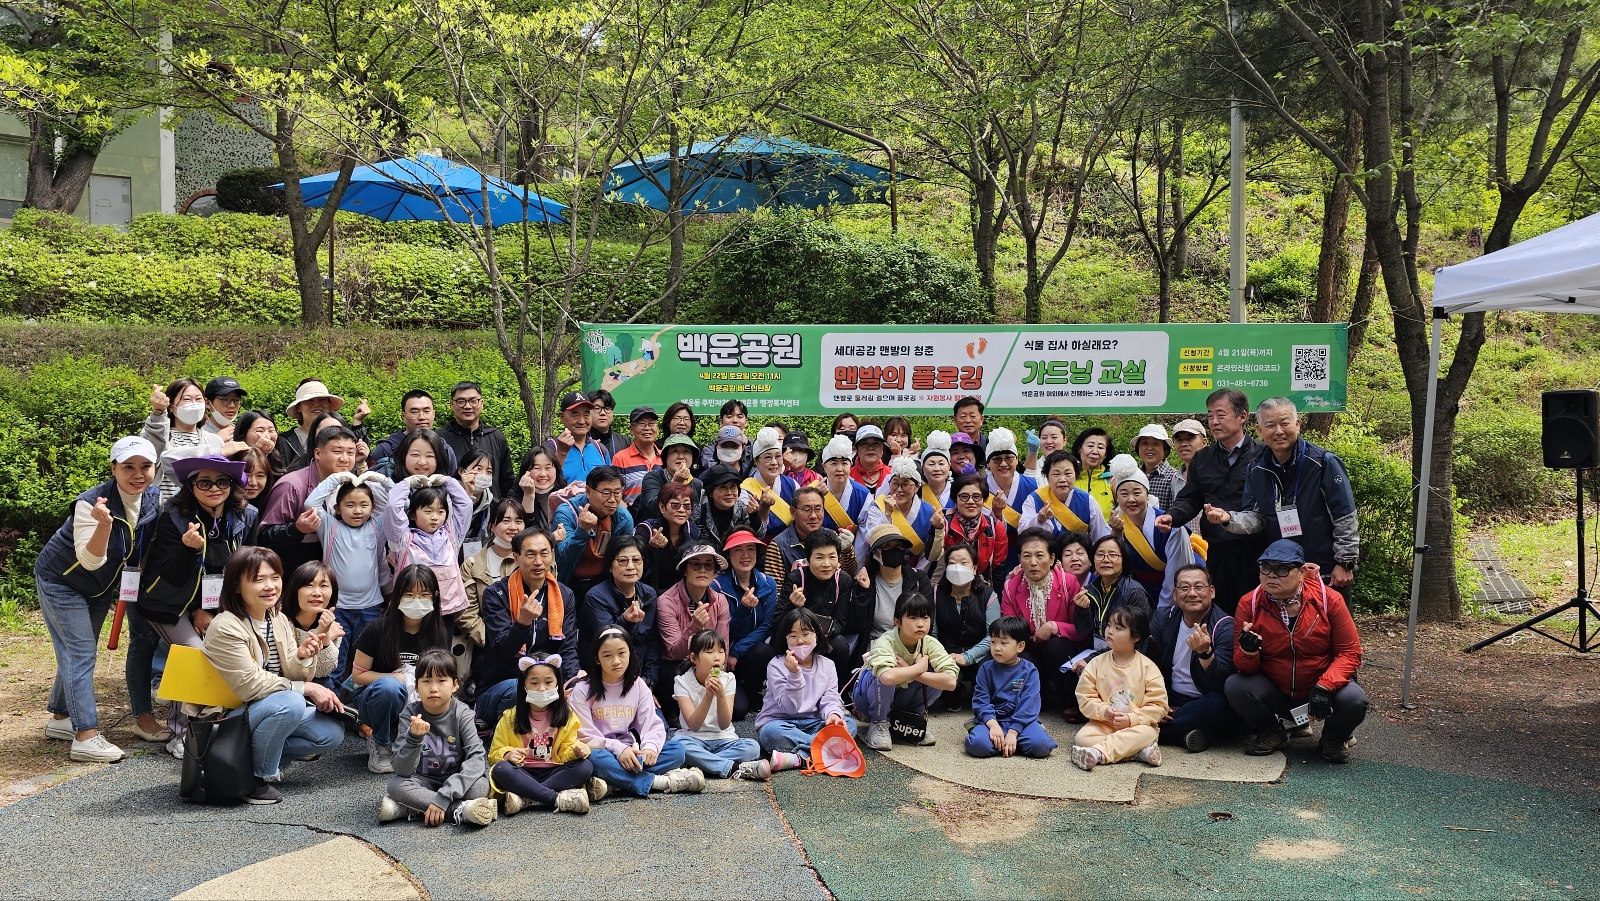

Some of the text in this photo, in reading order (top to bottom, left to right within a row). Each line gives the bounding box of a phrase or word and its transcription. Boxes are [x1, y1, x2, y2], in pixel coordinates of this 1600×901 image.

[1024, 339, 1118, 350] 식물 집사 하실래요?
[677, 333, 803, 368] 백운공원
[834, 345, 934, 356] 세대공감 맨발의 청춘
[1218, 348, 1273, 357] 4월 21일(목)까지
[1021, 359, 1147, 385] 가드닝 교실
[1182, 364, 1209, 372] 신청방법
[1216, 364, 1280, 372] 온라인신청(QR코드)
[699, 372, 781, 380] 4월 22일 토요일 오전 11시
[834, 365, 983, 390] 맨발의 플로깅
[708, 384, 772, 392] 백운공원 배드민턴장
[1134, 389, 1146, 397] 체험
[833, 394, 853, 402] 맨발로
[854, 394, 874, 402] 둘레길
[876, 394, 895, 402] 걸으며
[897, 394, 916, 402] 플로깅
[926, 394, 953, 402] 자원봉사
[760, 398, 800, 408] 행정복지센터
[892, 719, 925, 738] Super
